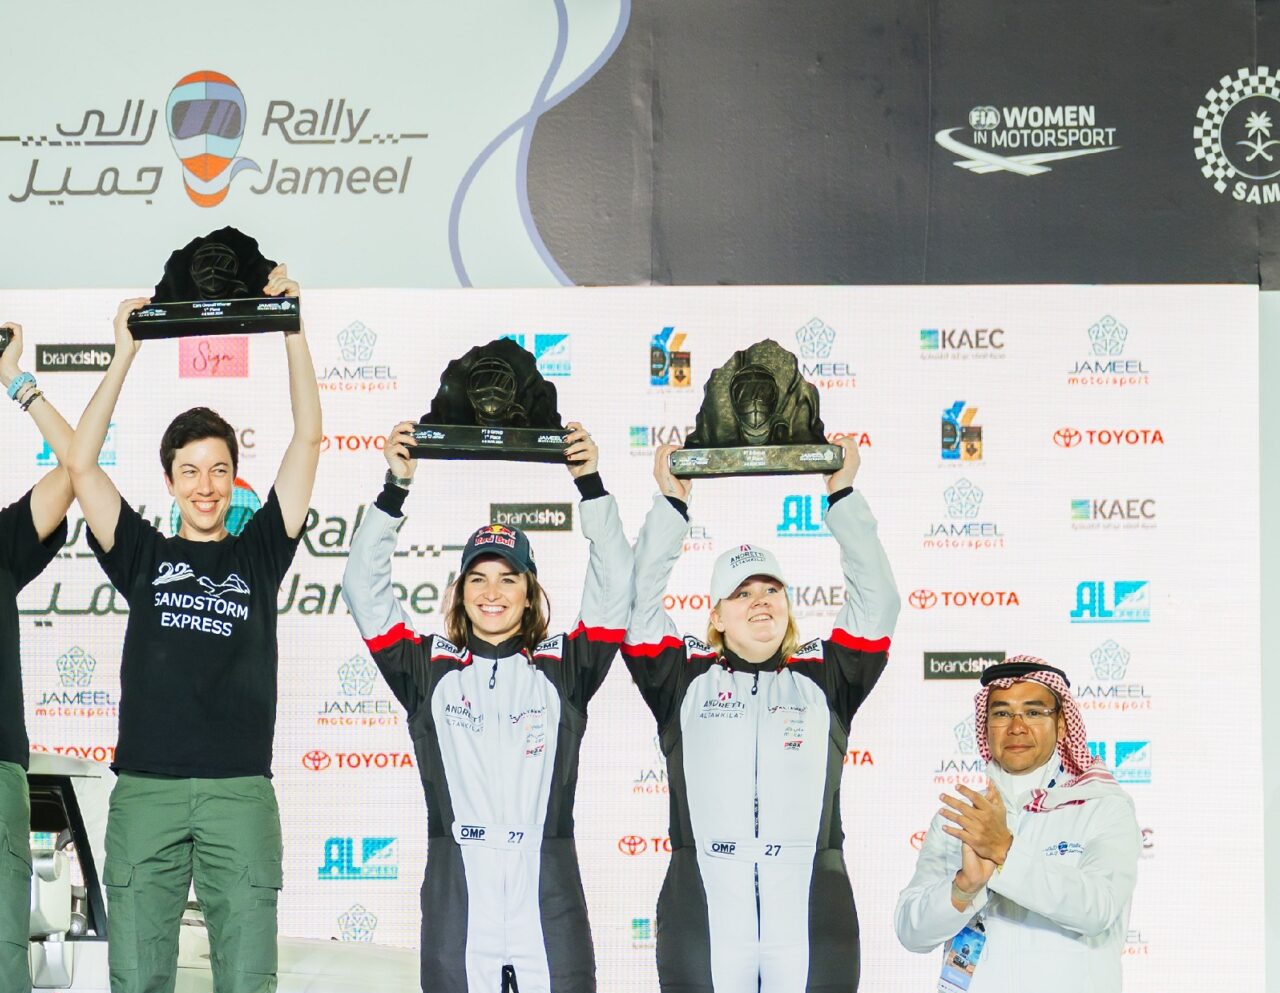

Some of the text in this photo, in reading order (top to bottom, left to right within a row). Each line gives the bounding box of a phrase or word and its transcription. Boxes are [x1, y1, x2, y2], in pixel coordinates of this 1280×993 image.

[261, 98, 372, 145] Rally
[969, 105, 1096, 130] FIA WOMEN
[973, 127, 1117, 149] IN MOTORSPORT
[249, 156, 413, 195] Jameel
[1232, 181, 1280, 205] SAM
[942, 329, 1004, 350] KAEC
[42, 350, 111, 367] brandshp
[192, 341, 234, 376] Sign
[1068, 360, 1149, 374] JAMEEL
[317, 366, 397, 380] JAMEEL
[802, 363, 856, 377] MEEL
[1068, 376, 1149, 387] motorsport
[334, 435, 386, 451] TOYO
[1086, 429, 1165, 445] TOYOTA
[497, 507, 567, 527] brandshp
[1092, 499, 1156, 520] KAEC
[924, 523, 1004, 537] JAMEEL
[923, 539, 1005, 550] motorsport
[663, 595, 712, 610] OYOT
[795, 585, 849, 607] KAE
[941, 590, 1020, 607] TOYOTA
[1070, 580, 1113, 618] AL
[154, 591, 249, 620] SANDSTORM
[160, 612, 233, 637] EXPRESS
[36, 690, 116, 705] JAMEEL
[1073, 685, 1151, 699] JAMEEL
[35, 706, 117, 718] motorsport
[318, 700, 398, 715] JAMEEL
[317, 716, 399, 728] motorsport
[335, 753, 414, 770] TOYOTA
[460, 827, 524, 844] OMP 27
[318, 837, 361, 876] AL
[711, 842, 781, 856] OMP 27
